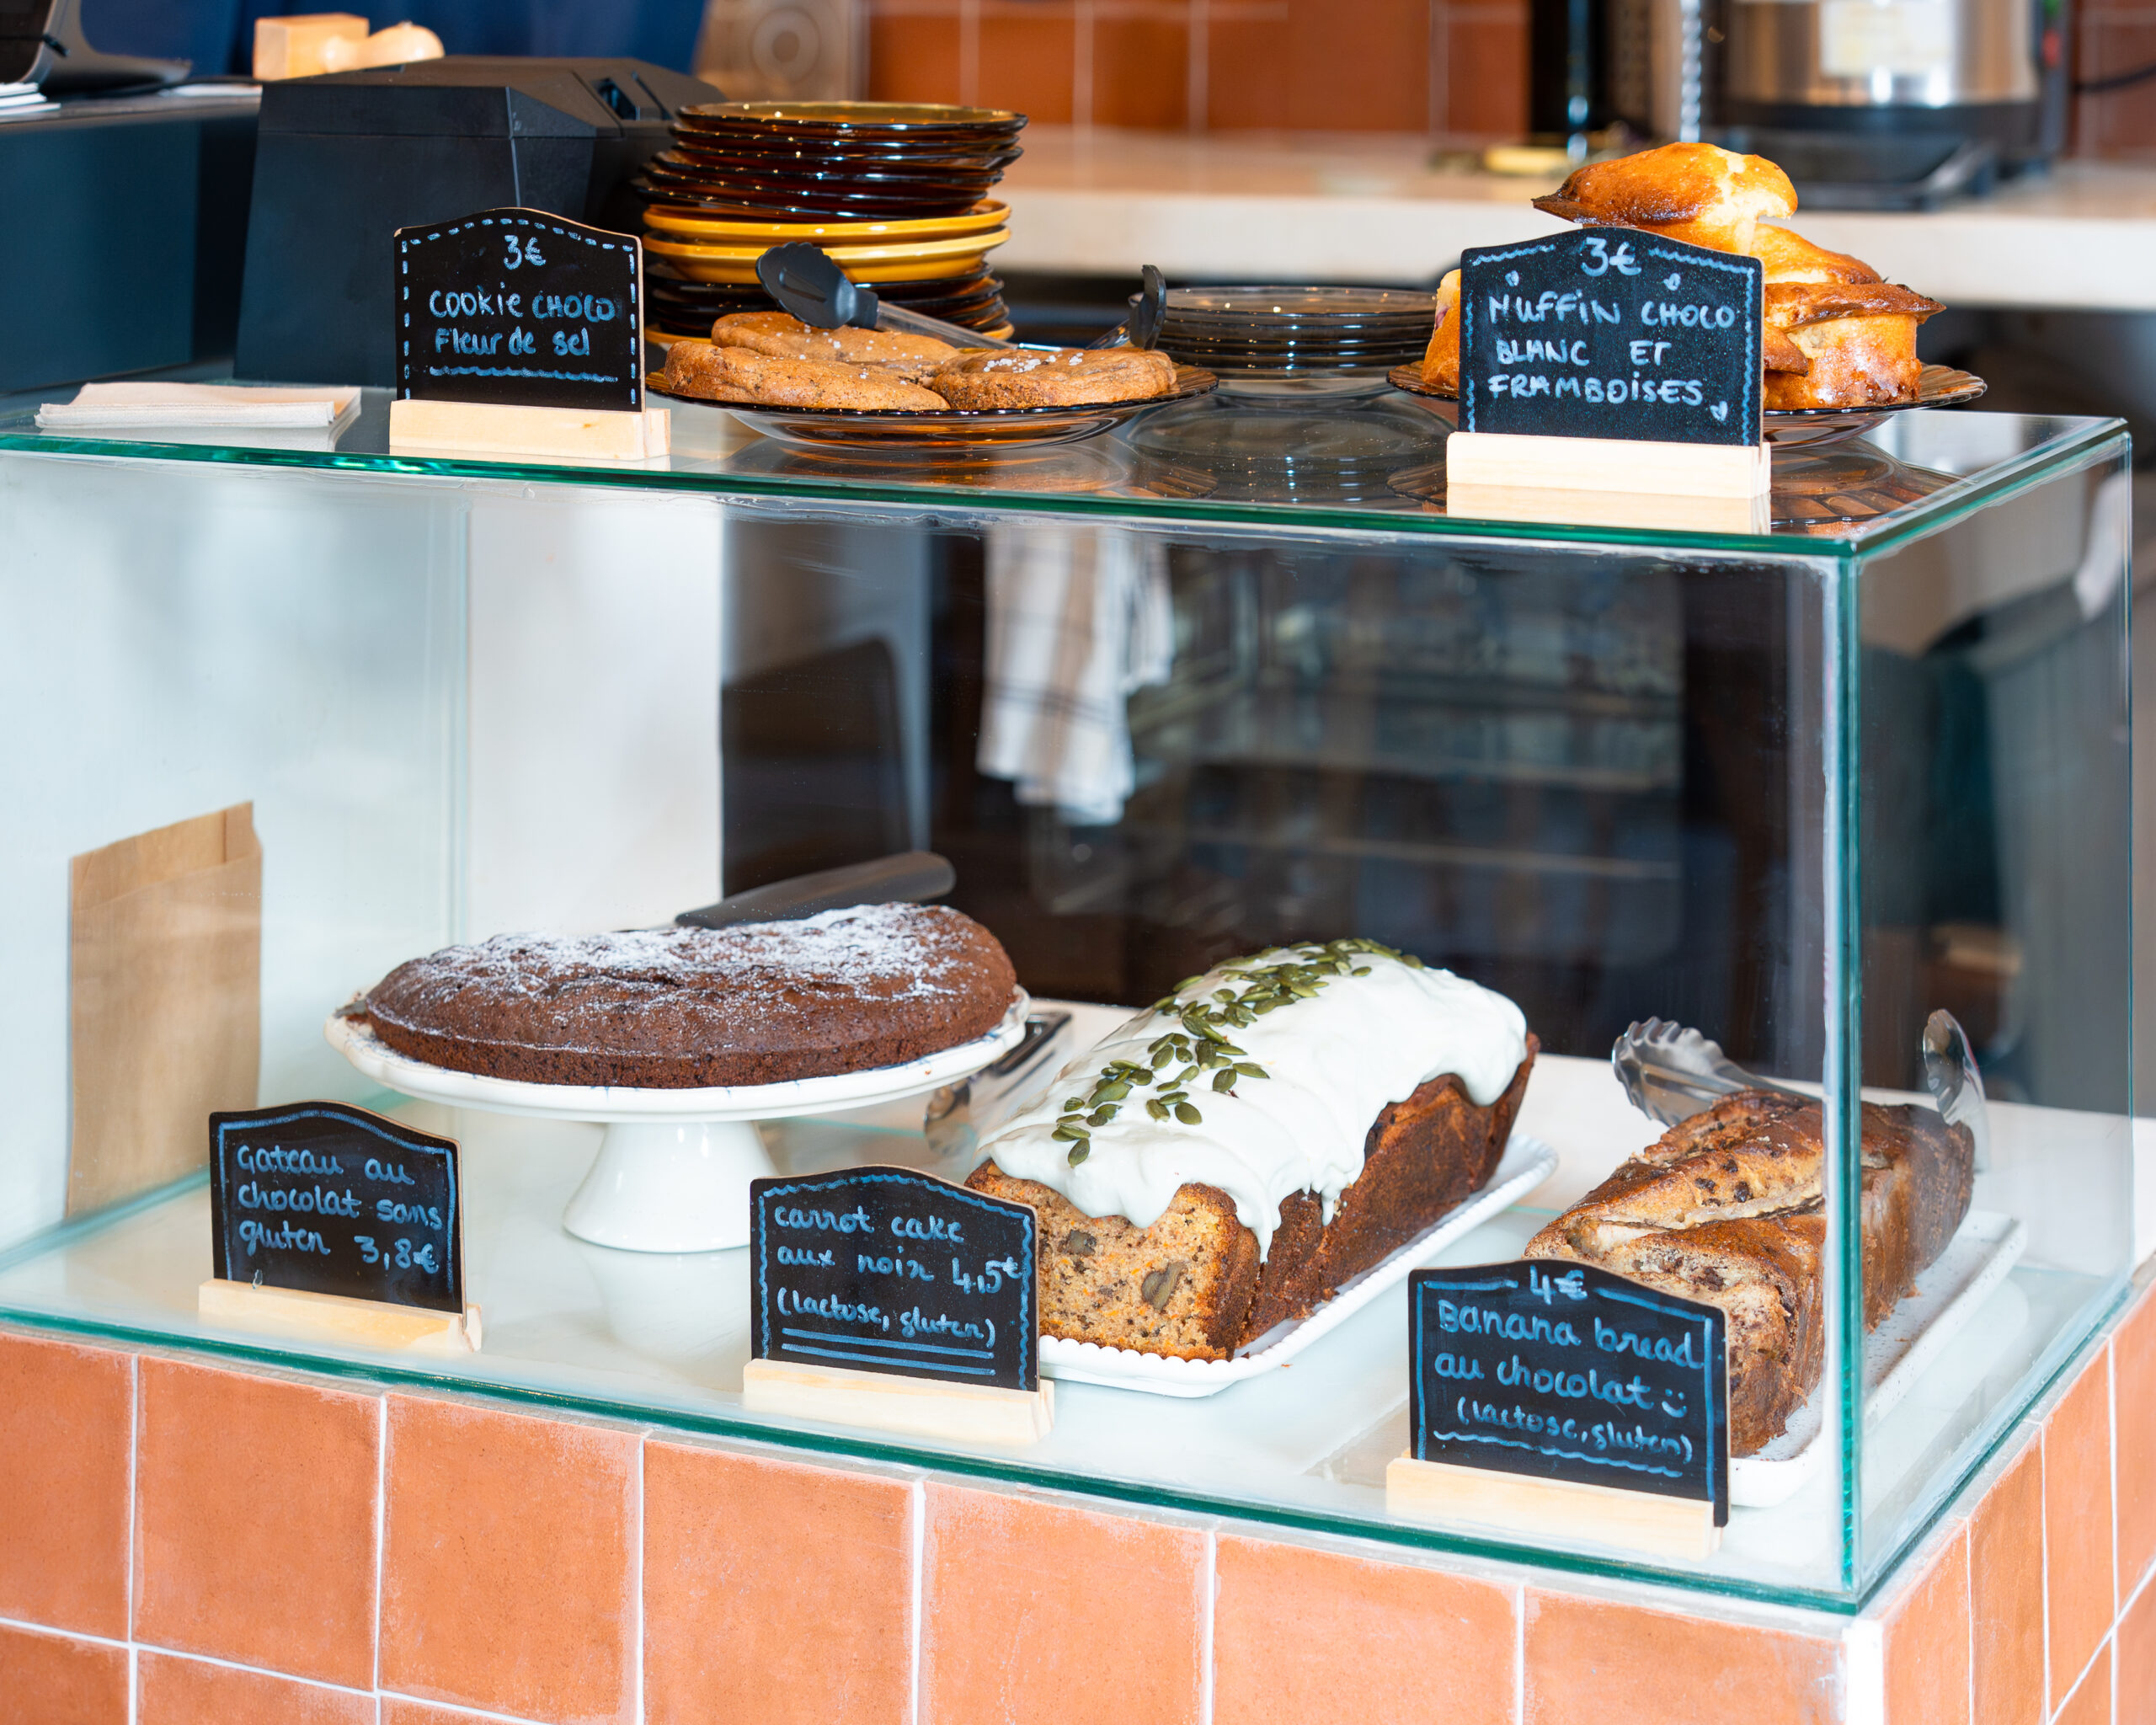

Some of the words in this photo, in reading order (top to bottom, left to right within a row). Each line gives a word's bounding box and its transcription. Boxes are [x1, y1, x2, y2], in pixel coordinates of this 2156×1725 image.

[504, 235, 546, 270] 3€
[1580, 237, 1641, 276] 3€
[1641, 301, 1735, 329] CHOCO
[509, 326, 536, 355] de
[552, 327, 590, 355] sel
[1496, 339, 1589, 366] BLANC
[1629, 340, 1672, 366] ET
[365, 1158, 415, 1185] au
[376, 1199, 443, 1231] sans
[774, 1205, 875, 1233] carrot
[890, 1215, 964, 1242] cake
[239, 1220, 331, 1256] gluten
[354, 1235, 439, 1274] 3,8€
[777, 1246, 835, 1267] aux
[1529, 1265, 1588, 1305] 4€
[1438, 1299, 1582, 1346] Banana
[1594, 1316, 1705, 1370] bread
[1434, 1352, 1485, 1380] au
[1496, 1354, 1655, 1410] chocolat
